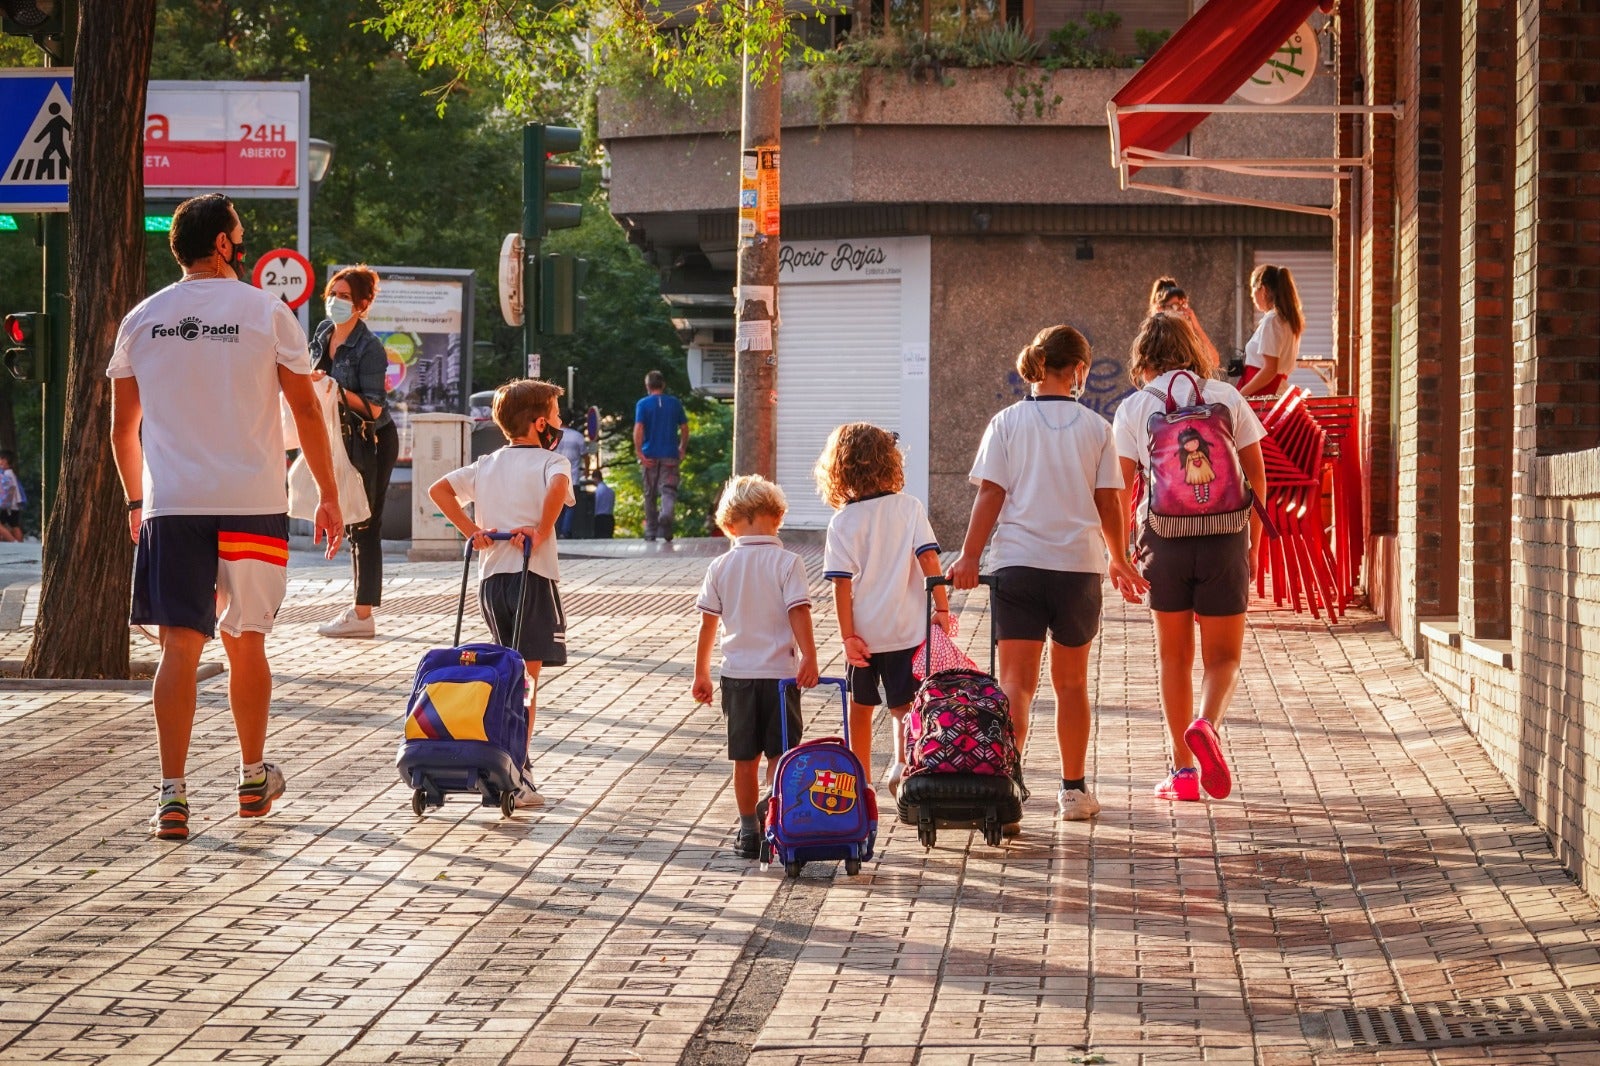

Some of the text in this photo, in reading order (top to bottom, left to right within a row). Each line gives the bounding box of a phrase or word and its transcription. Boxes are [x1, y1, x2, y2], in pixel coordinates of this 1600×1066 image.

[240, 124, 286, 143] 24H
[240, 148, 287, 158] ABIERTO
[144, 156, 170, 168] ETA
[779, 243, 887, 273] Rocio Rojas
[290, 276, 302, 285] m
[151, 324, 239, 339] Feel Padel
